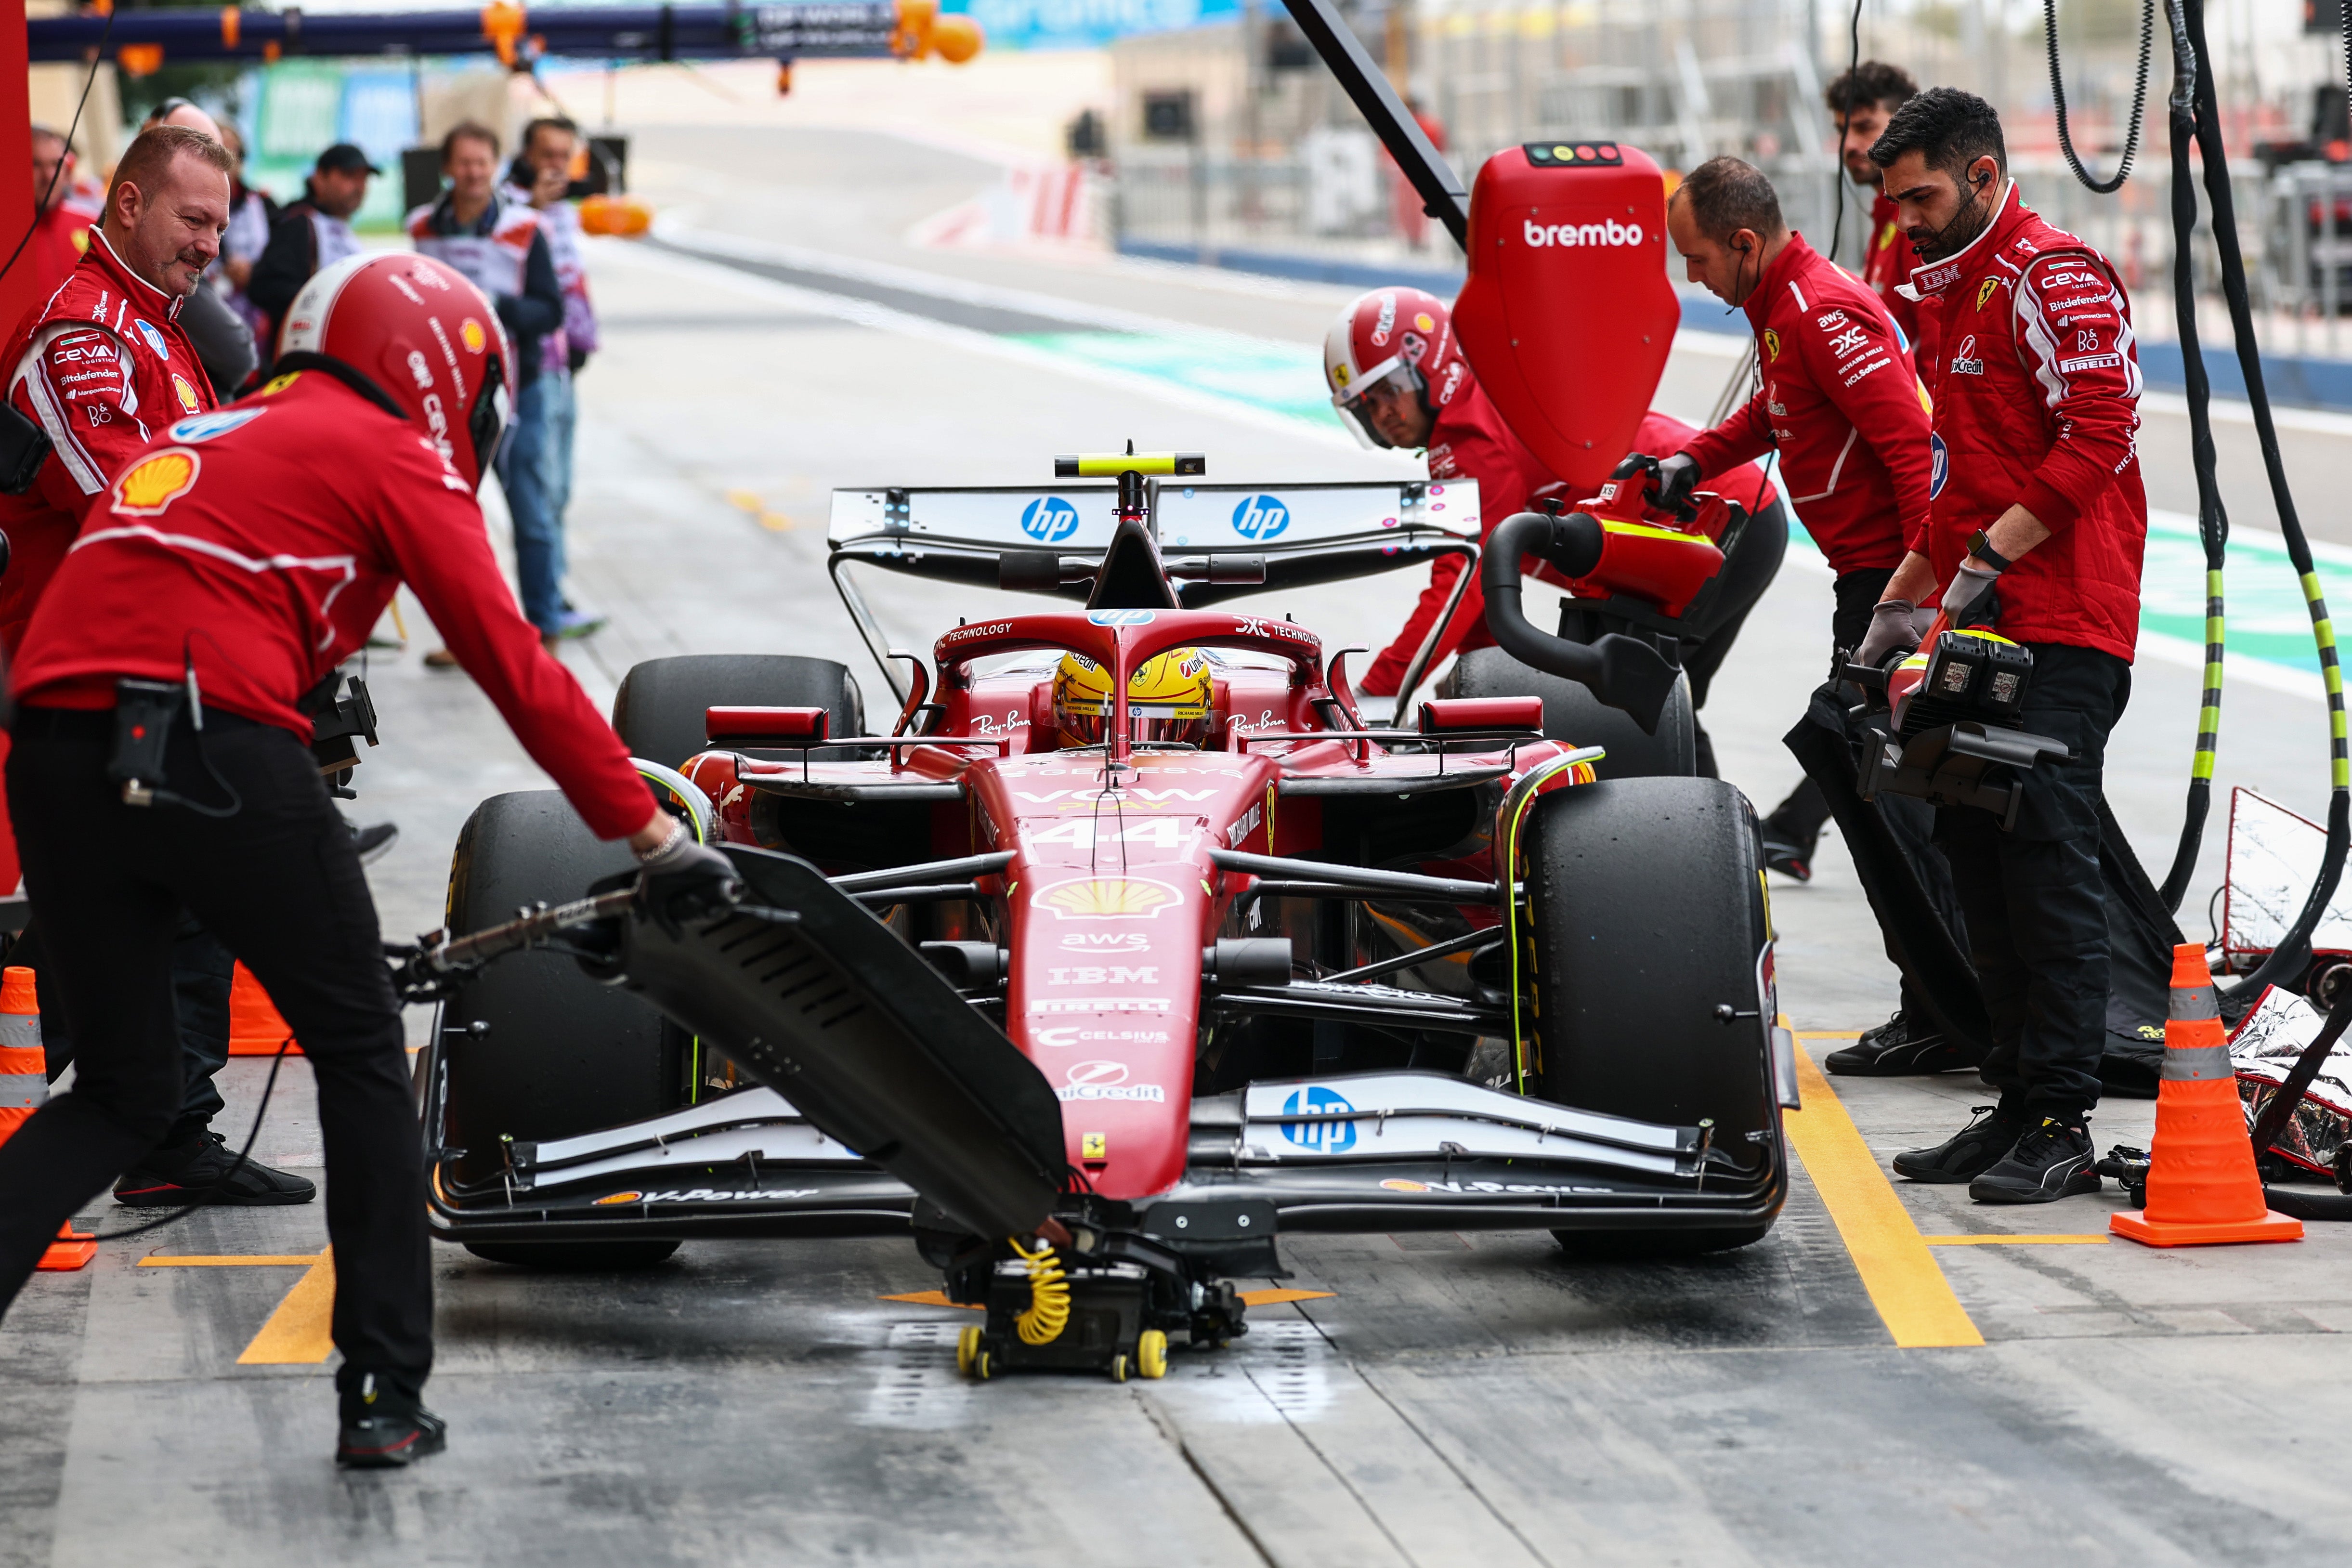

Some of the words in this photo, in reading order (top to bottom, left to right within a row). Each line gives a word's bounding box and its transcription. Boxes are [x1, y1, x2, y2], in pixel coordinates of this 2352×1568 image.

[1524, 218, 1643, 247] brembo
[1921, 263, 1961, 290] IBM
[2049, 293, 2108, 312] Bitdefender
[1817, 310, 1844, 327] aws
[2069, 313, 2112, 322] ManpowerGroup
[1829, 326, 1867, 355] DXC
[1838, 340, 1869, 359] TECHNOLOGY
[1838, 354, 1866, 375] RICHARD
[1865, 346, 1884, 357] MILLE
[1952, 359, 1982, 373] niCredit
[2060, 353, 2120, 373] PIRELLI
[60, 369, 119, 386] Bitdefender
[1844, 357, 1891, 388] HCLSoftware
[78, 387, 121, 396] ManpowerGroup
[1602, 486, 1614, 496] XS
[1026, 496, 1075, 542] hp
[1238, 494, 1286, 540] hp
[1097, 609, 1147, 625] hp
[949, 623, 1013, 642] TECHNOLOGY
[1232, 615, 1270, 638] DXC
[1273, 625, 1323, 648] TECHNOLOGY
[1133, 707, 1141, 716] hp
[971, 710, 1032, 735] Ray-Ban
[1226, 710, 1286, 733] Ray-Ban
[1039, 767, 1243, 779] GEESYS
[1012, 788, 1220, 803] VGW
[1057, 801, 1173, 810] PLAY
[1029, 818, 1192, 849] 44
[1227, 812, 1248, 850] RICHARD
[1248, 801, 1260, 833] MILLE
[1061, 933, 1148, 945] aws
[1047, 966, 1159, 985] IBM
[1031, 997, 1172, 1012] PIRELLI
[1057, 1086, 1162, 1100] niCredit
[1294, 1084, 1349, 1154] hp
[642, 1189, 819, 1202] V-Power
[1426, 1181, 1613, 1193] V-Power
